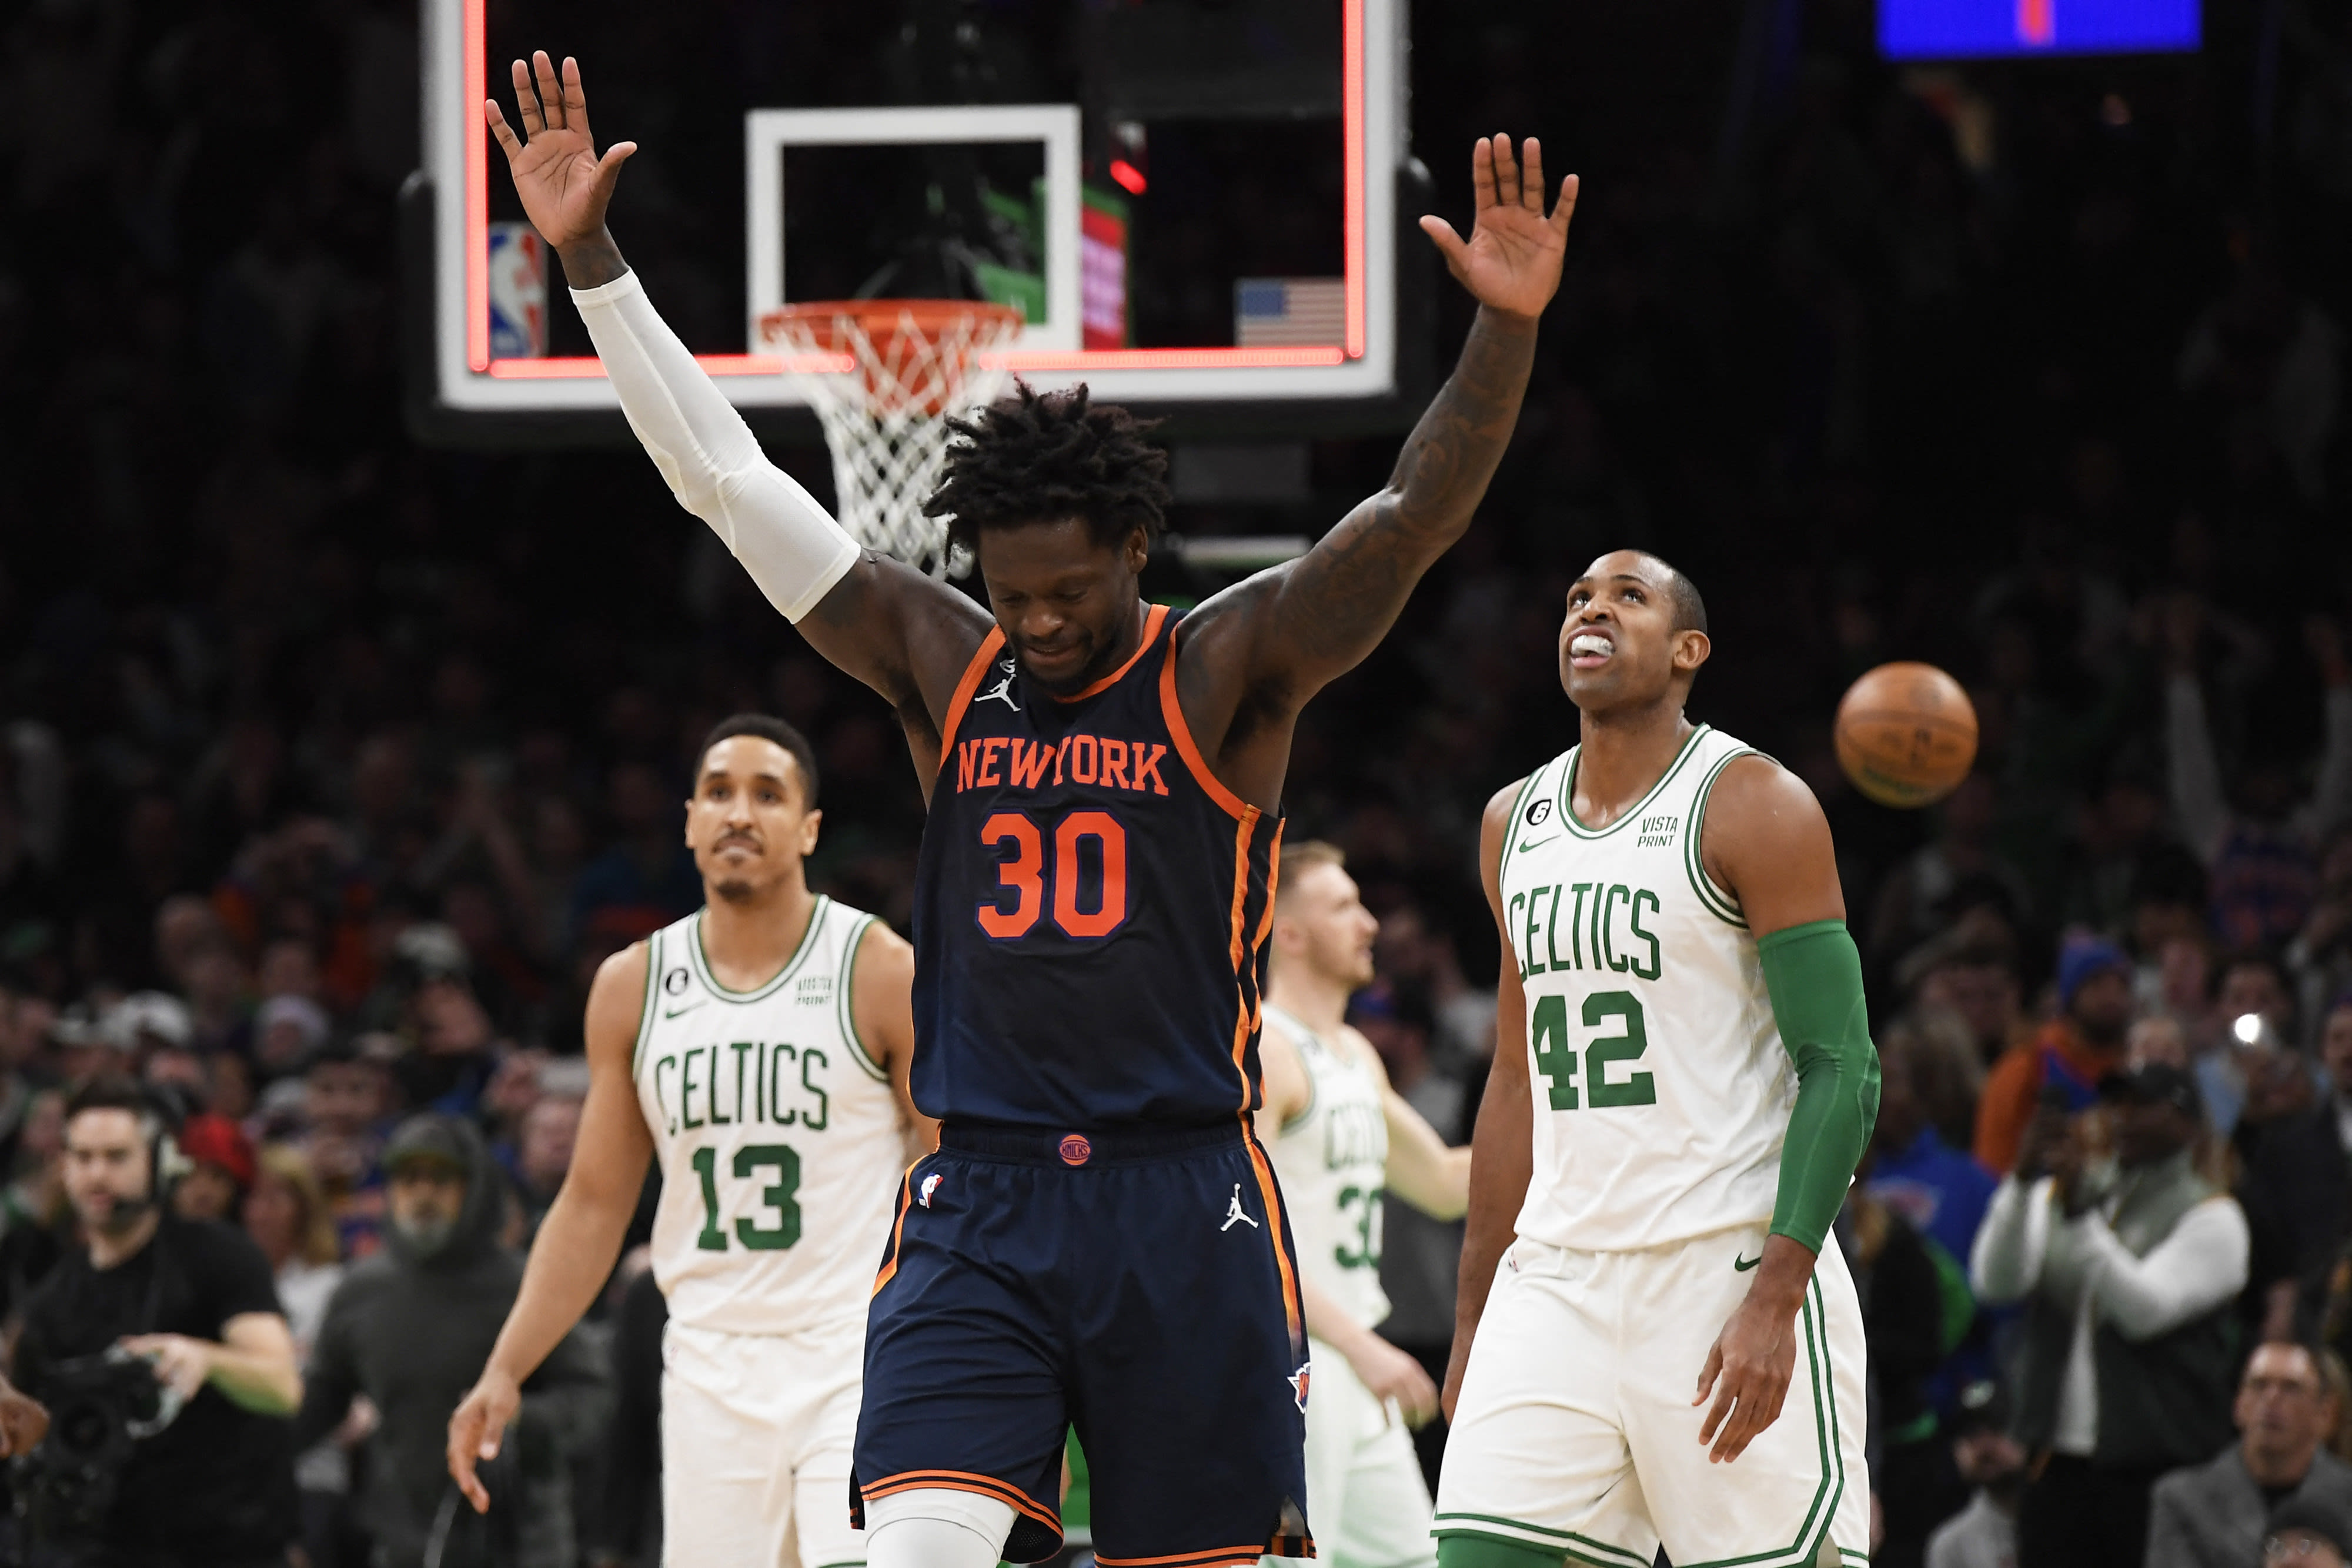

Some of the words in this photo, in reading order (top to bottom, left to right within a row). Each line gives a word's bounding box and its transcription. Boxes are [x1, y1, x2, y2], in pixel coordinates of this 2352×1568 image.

[1638, 835, 1675, 848] PRINT
[1642, 816, 1678, 833] VISTA
[977, 810, 1127, 939] 30
[1509, 882, 1661, 981] CELTICS
[656, 1042, 828, 1137] CELTICS
[1532, 990, 1657, 1111] 42
[693, 1144, 801, 1252] 13
